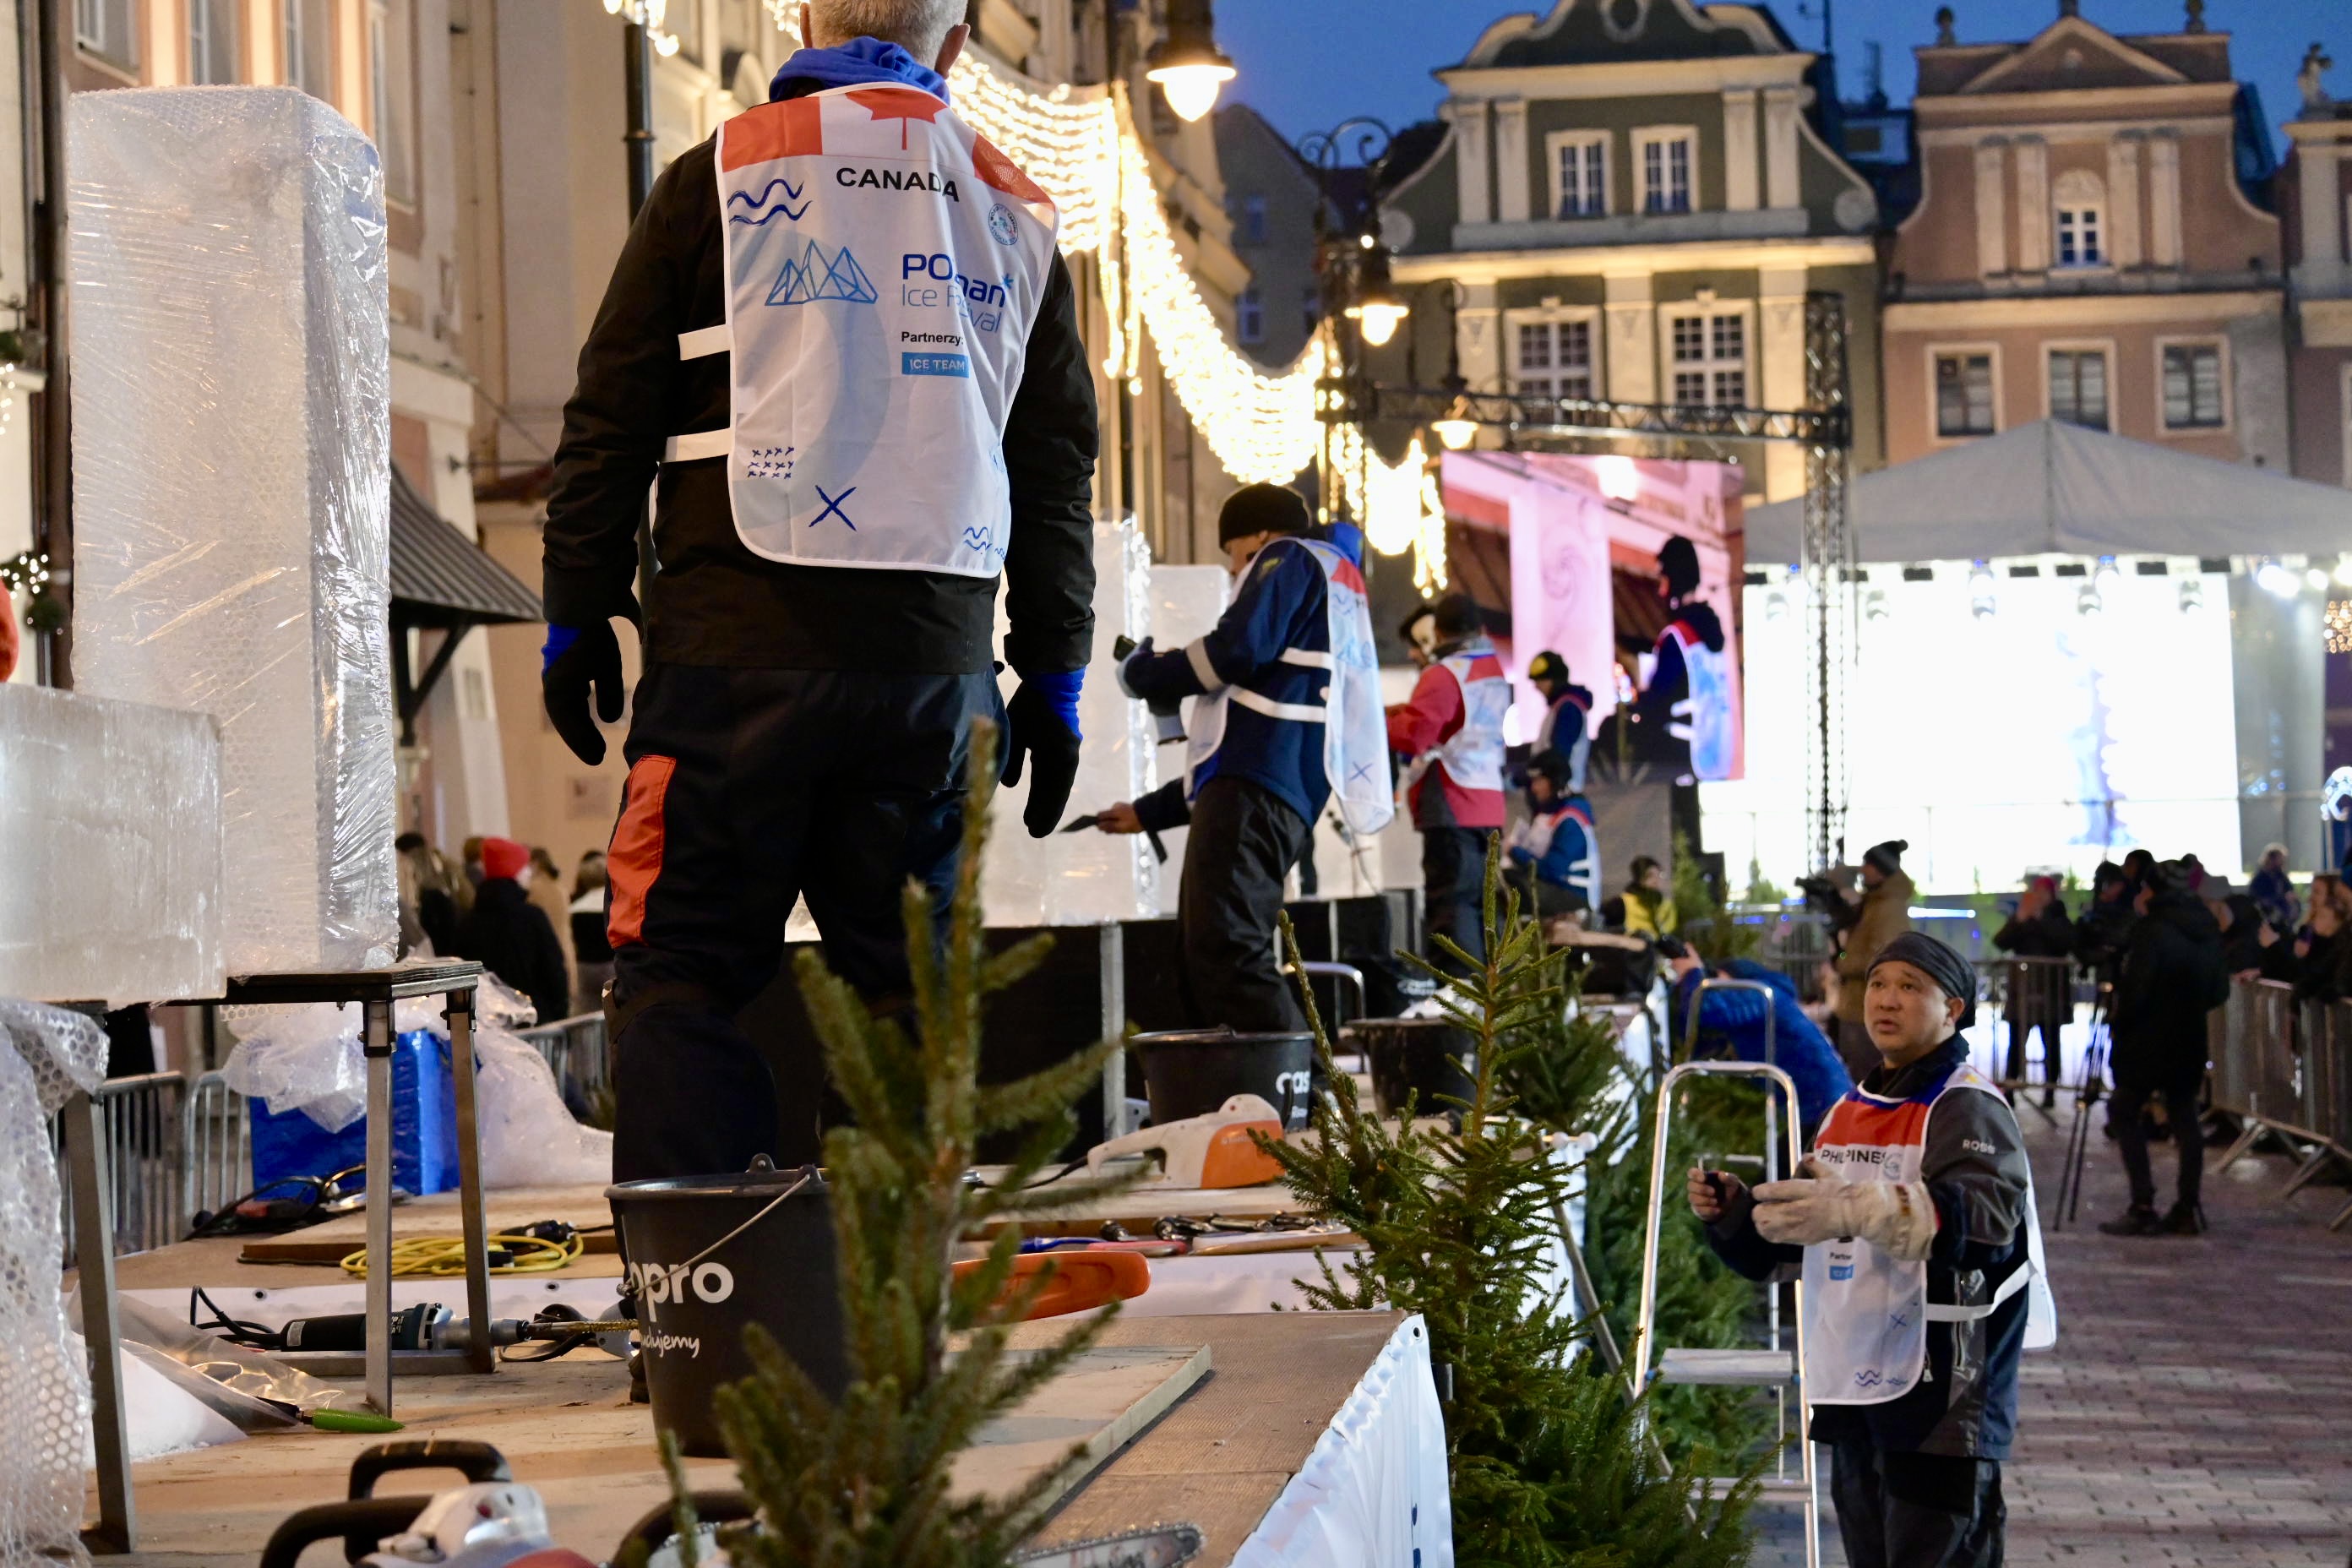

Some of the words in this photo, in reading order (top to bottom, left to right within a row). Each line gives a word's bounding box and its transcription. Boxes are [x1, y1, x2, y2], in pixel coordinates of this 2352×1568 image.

[836, 168, 960, 202] CANADA
[902, 284, 938, 308] Ice
[901, 331, 964, 346] Partnerzy:
[910, 358, 929, 370] ICE
[933, 359, 966, 372] TEAM
